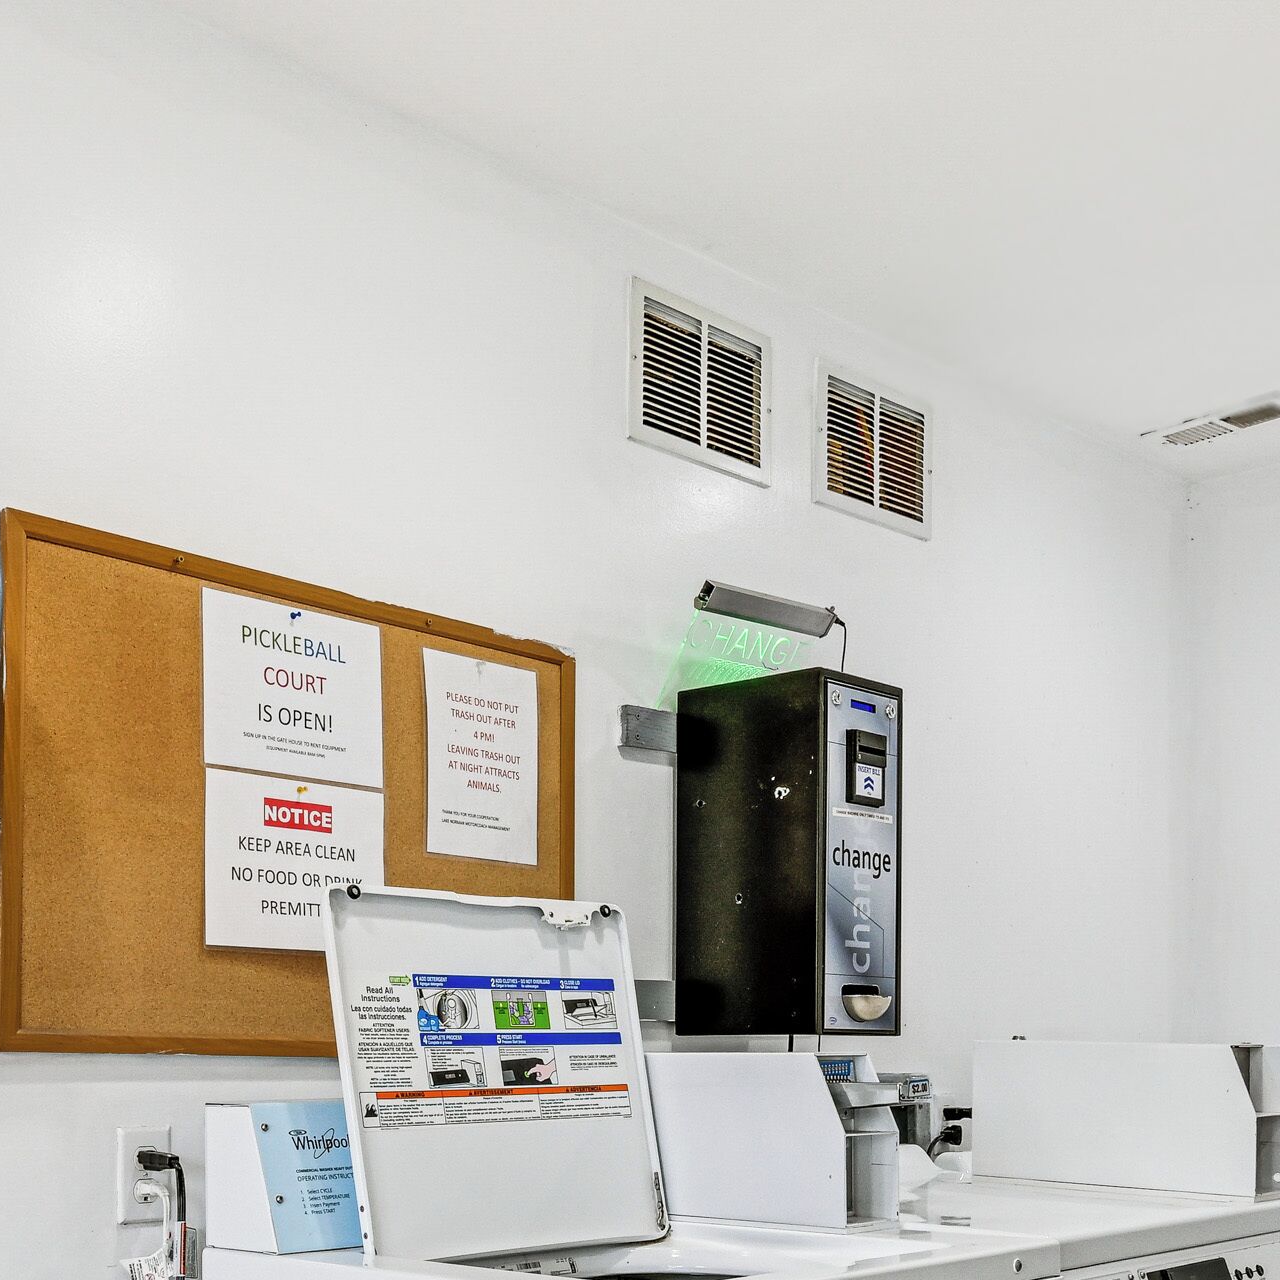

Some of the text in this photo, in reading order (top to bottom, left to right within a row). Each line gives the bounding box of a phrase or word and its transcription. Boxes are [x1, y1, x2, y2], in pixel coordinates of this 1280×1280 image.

[241, 625, 347, 664] PICKLEBALL
[263, 666, 327, 695] COURT
[446, 691, 519, 714] PLEASE DO NOT PUT
[258, 703, 333, 733] IS OPEN!
[451, 708, 516, 729] TRASH OUT AFTER
[473, 731, 495, 743] 4 PM!
[322, 744, 347, 752] EQUIPMENT
[447, 744, 521, 765] LEAVING TRASH OUT
[448, 760, 520, 781] AT NIGHT ATTRACTS
[858, 765, 881, 776] INSERT BILL
[264, 804, 332, 829] NOTICE
[238, 835, 355, 862] KEEP AREA CLEAN
[832, 839, 892, 880] change
[231, 866, 253, 882] NO
[257, 869, 297, 886] FOOD
[302, 873, 321, 887] OR
[415, 976, 420, 986] 1
[490, 978, 496, 987] 2
[560, 980, 565, 989] 3
[366, 986, 394, 994] Read All
[361, 994, 401, 1003] Instructions
[373, 1005, 396, 1013] cuidado
[358, 1012, 368, 1020] las
[423, 1036, 428, 1044] 4
[496, 1035, 502, 1044] 5
[474, 1088, 514, 1097] AVERTISSEMENT
[297, 1174, 328, 1182] OPERATING
